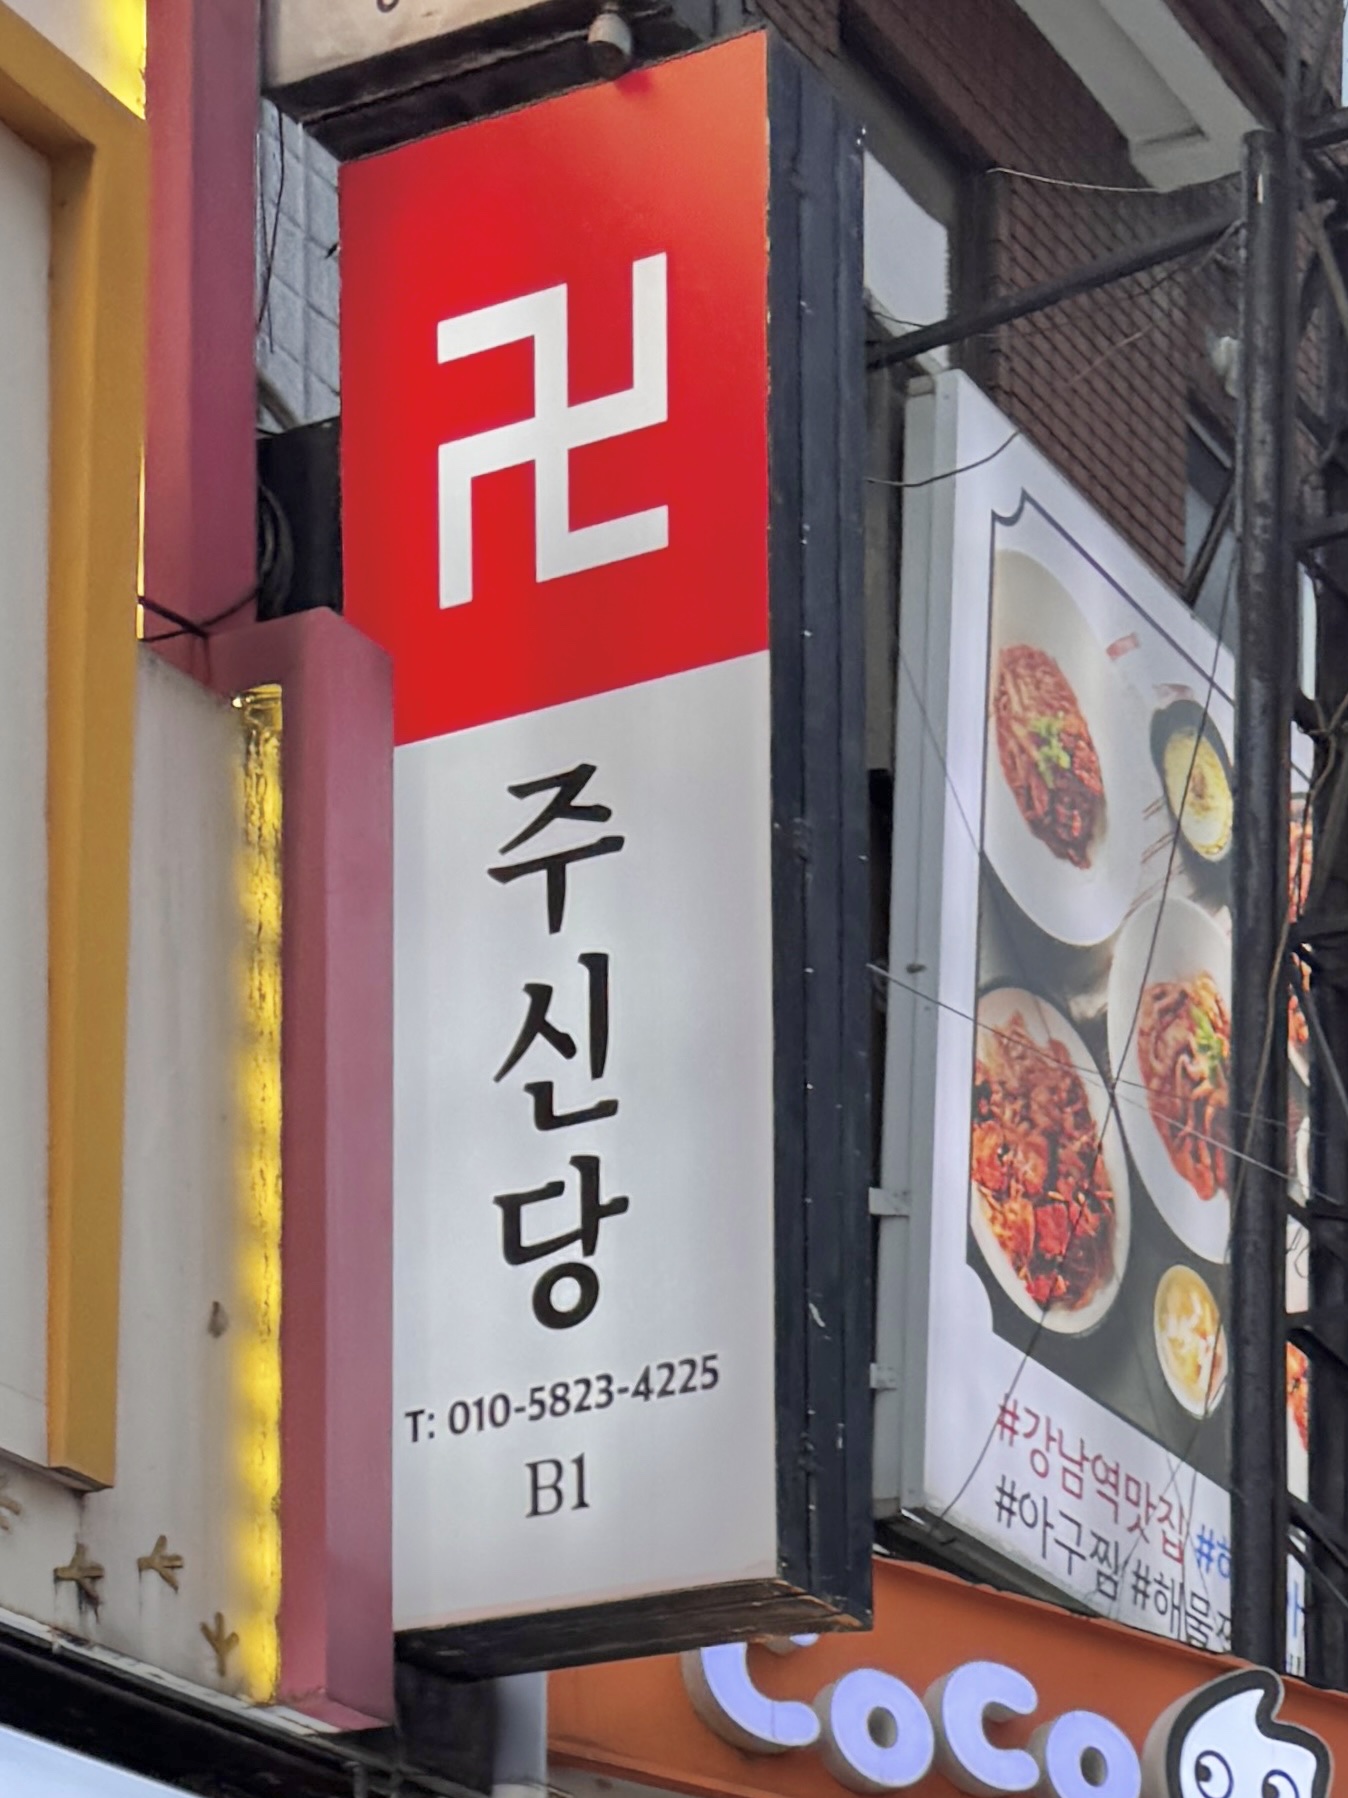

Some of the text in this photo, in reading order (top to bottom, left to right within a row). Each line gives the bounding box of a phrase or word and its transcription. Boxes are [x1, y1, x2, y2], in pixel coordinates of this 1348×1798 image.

[488, 762, 629, 1330] 주신당
[406, 1354, 721, 1442] T: 010-5823-4225
[525, 1453, 591, 1519] B1
[995, 1474, 1119, 1601] #아구찜
[997, 1393, 1183, 1565] #강남역맛집
